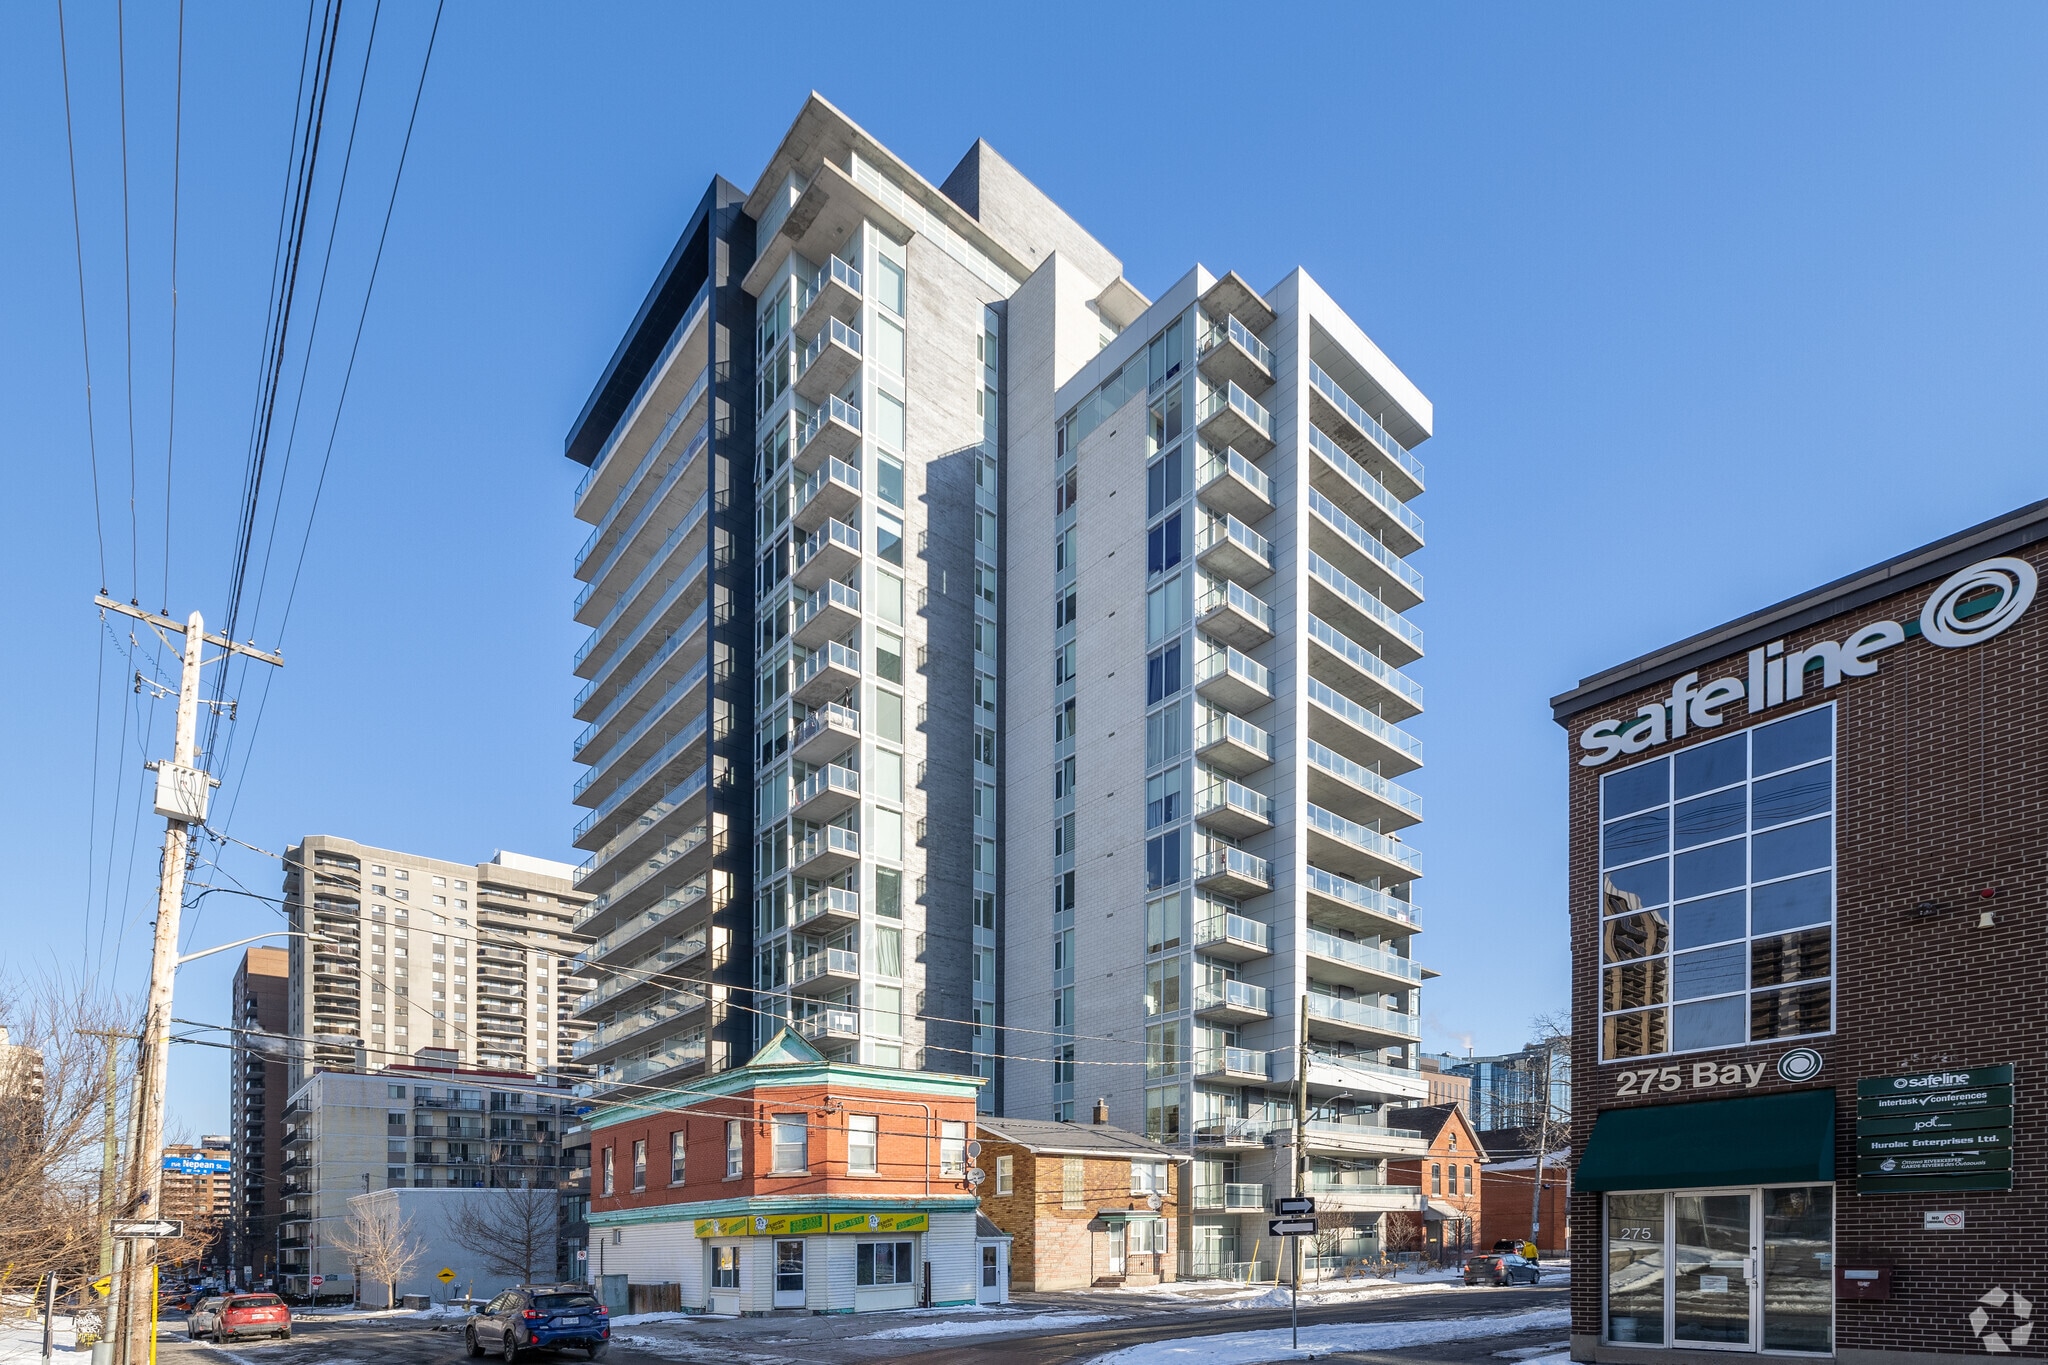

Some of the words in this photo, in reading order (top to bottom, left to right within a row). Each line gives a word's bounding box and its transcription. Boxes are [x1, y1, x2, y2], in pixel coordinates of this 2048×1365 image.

[1579, 620, 1905, 767] safeline
[1616, 1066, 1682, 1096] 275
[1692, 1062, 1767, 1088] Bay
[1908, 1073, 1970, 1088] safeline
[1878, 1098, 1918, 1107] intertask
[1930, 1092, 1988, 1103] conferences
[1871, 1141, 1909, 1149] Hurolac
[1912, 1136, 1974, 1147] Enterprises
[1977, 1135, 2000, 1143] Ltd.
[182, 1160, 215, 1170] Nepean
[1621, 1227, 1652, 1240] 275
